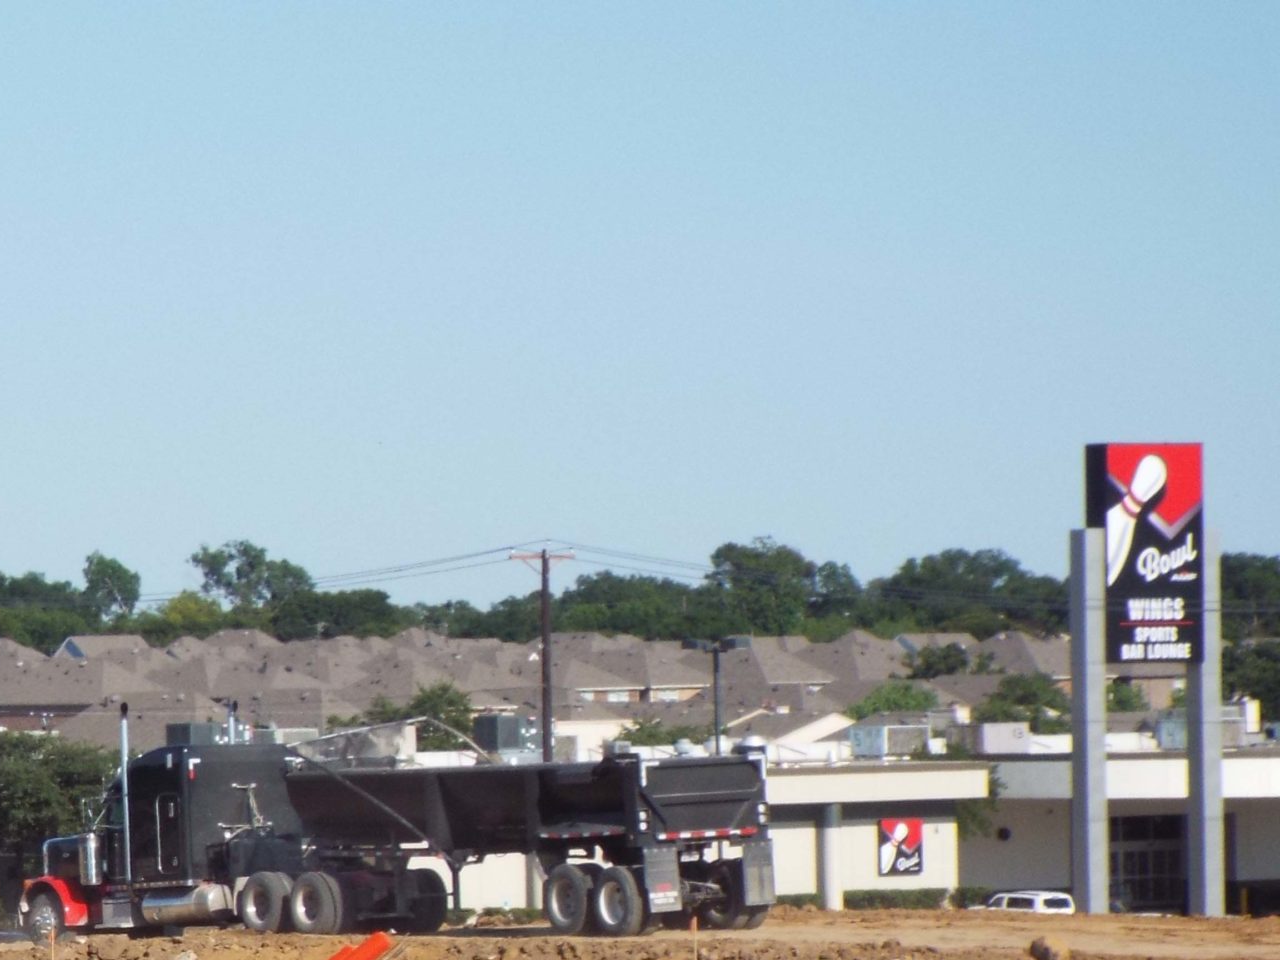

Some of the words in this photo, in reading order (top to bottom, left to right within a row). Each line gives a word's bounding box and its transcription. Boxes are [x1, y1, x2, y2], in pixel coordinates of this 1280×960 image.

[1136, 532, 1197, 582] Bowl
[1128, 598, 1184, 621] WINGS
[1134, 626, 1178, 642] SPORTS
[1121, 643, 1145, 660] BAR
[1147, 642, 1191, 660] LOUNGE
